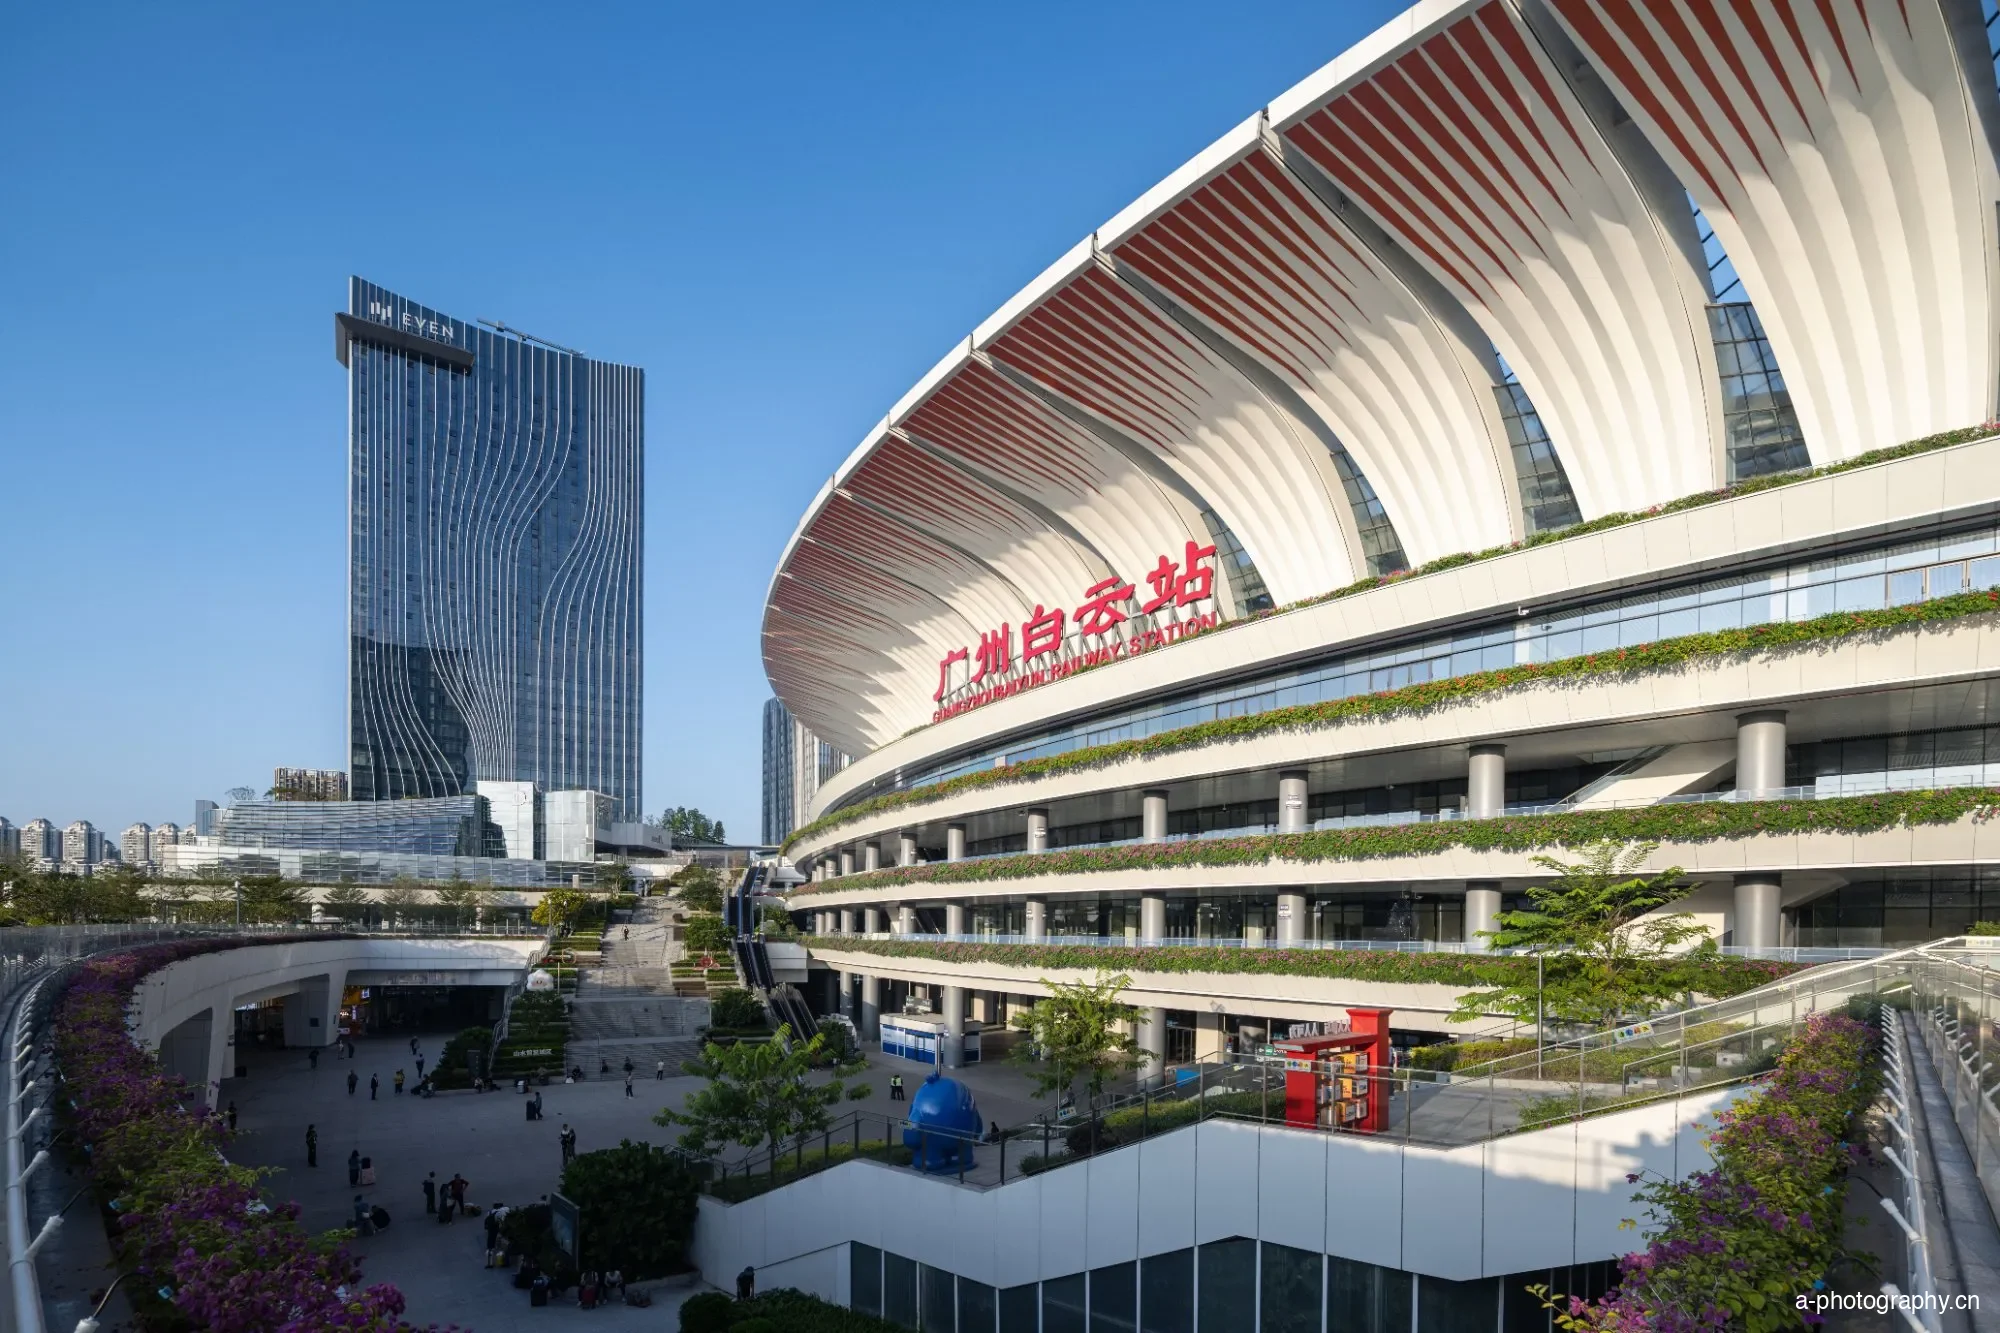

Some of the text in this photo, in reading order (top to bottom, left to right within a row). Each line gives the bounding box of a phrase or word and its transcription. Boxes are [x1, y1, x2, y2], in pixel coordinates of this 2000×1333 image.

[402, 312, 453, 339] EVEN
[933, 540, 1217, 702] 广州白云站
[1051, 641, 1122, 681] RAILWAY
[1129, 611, 1217, 656] STATION
